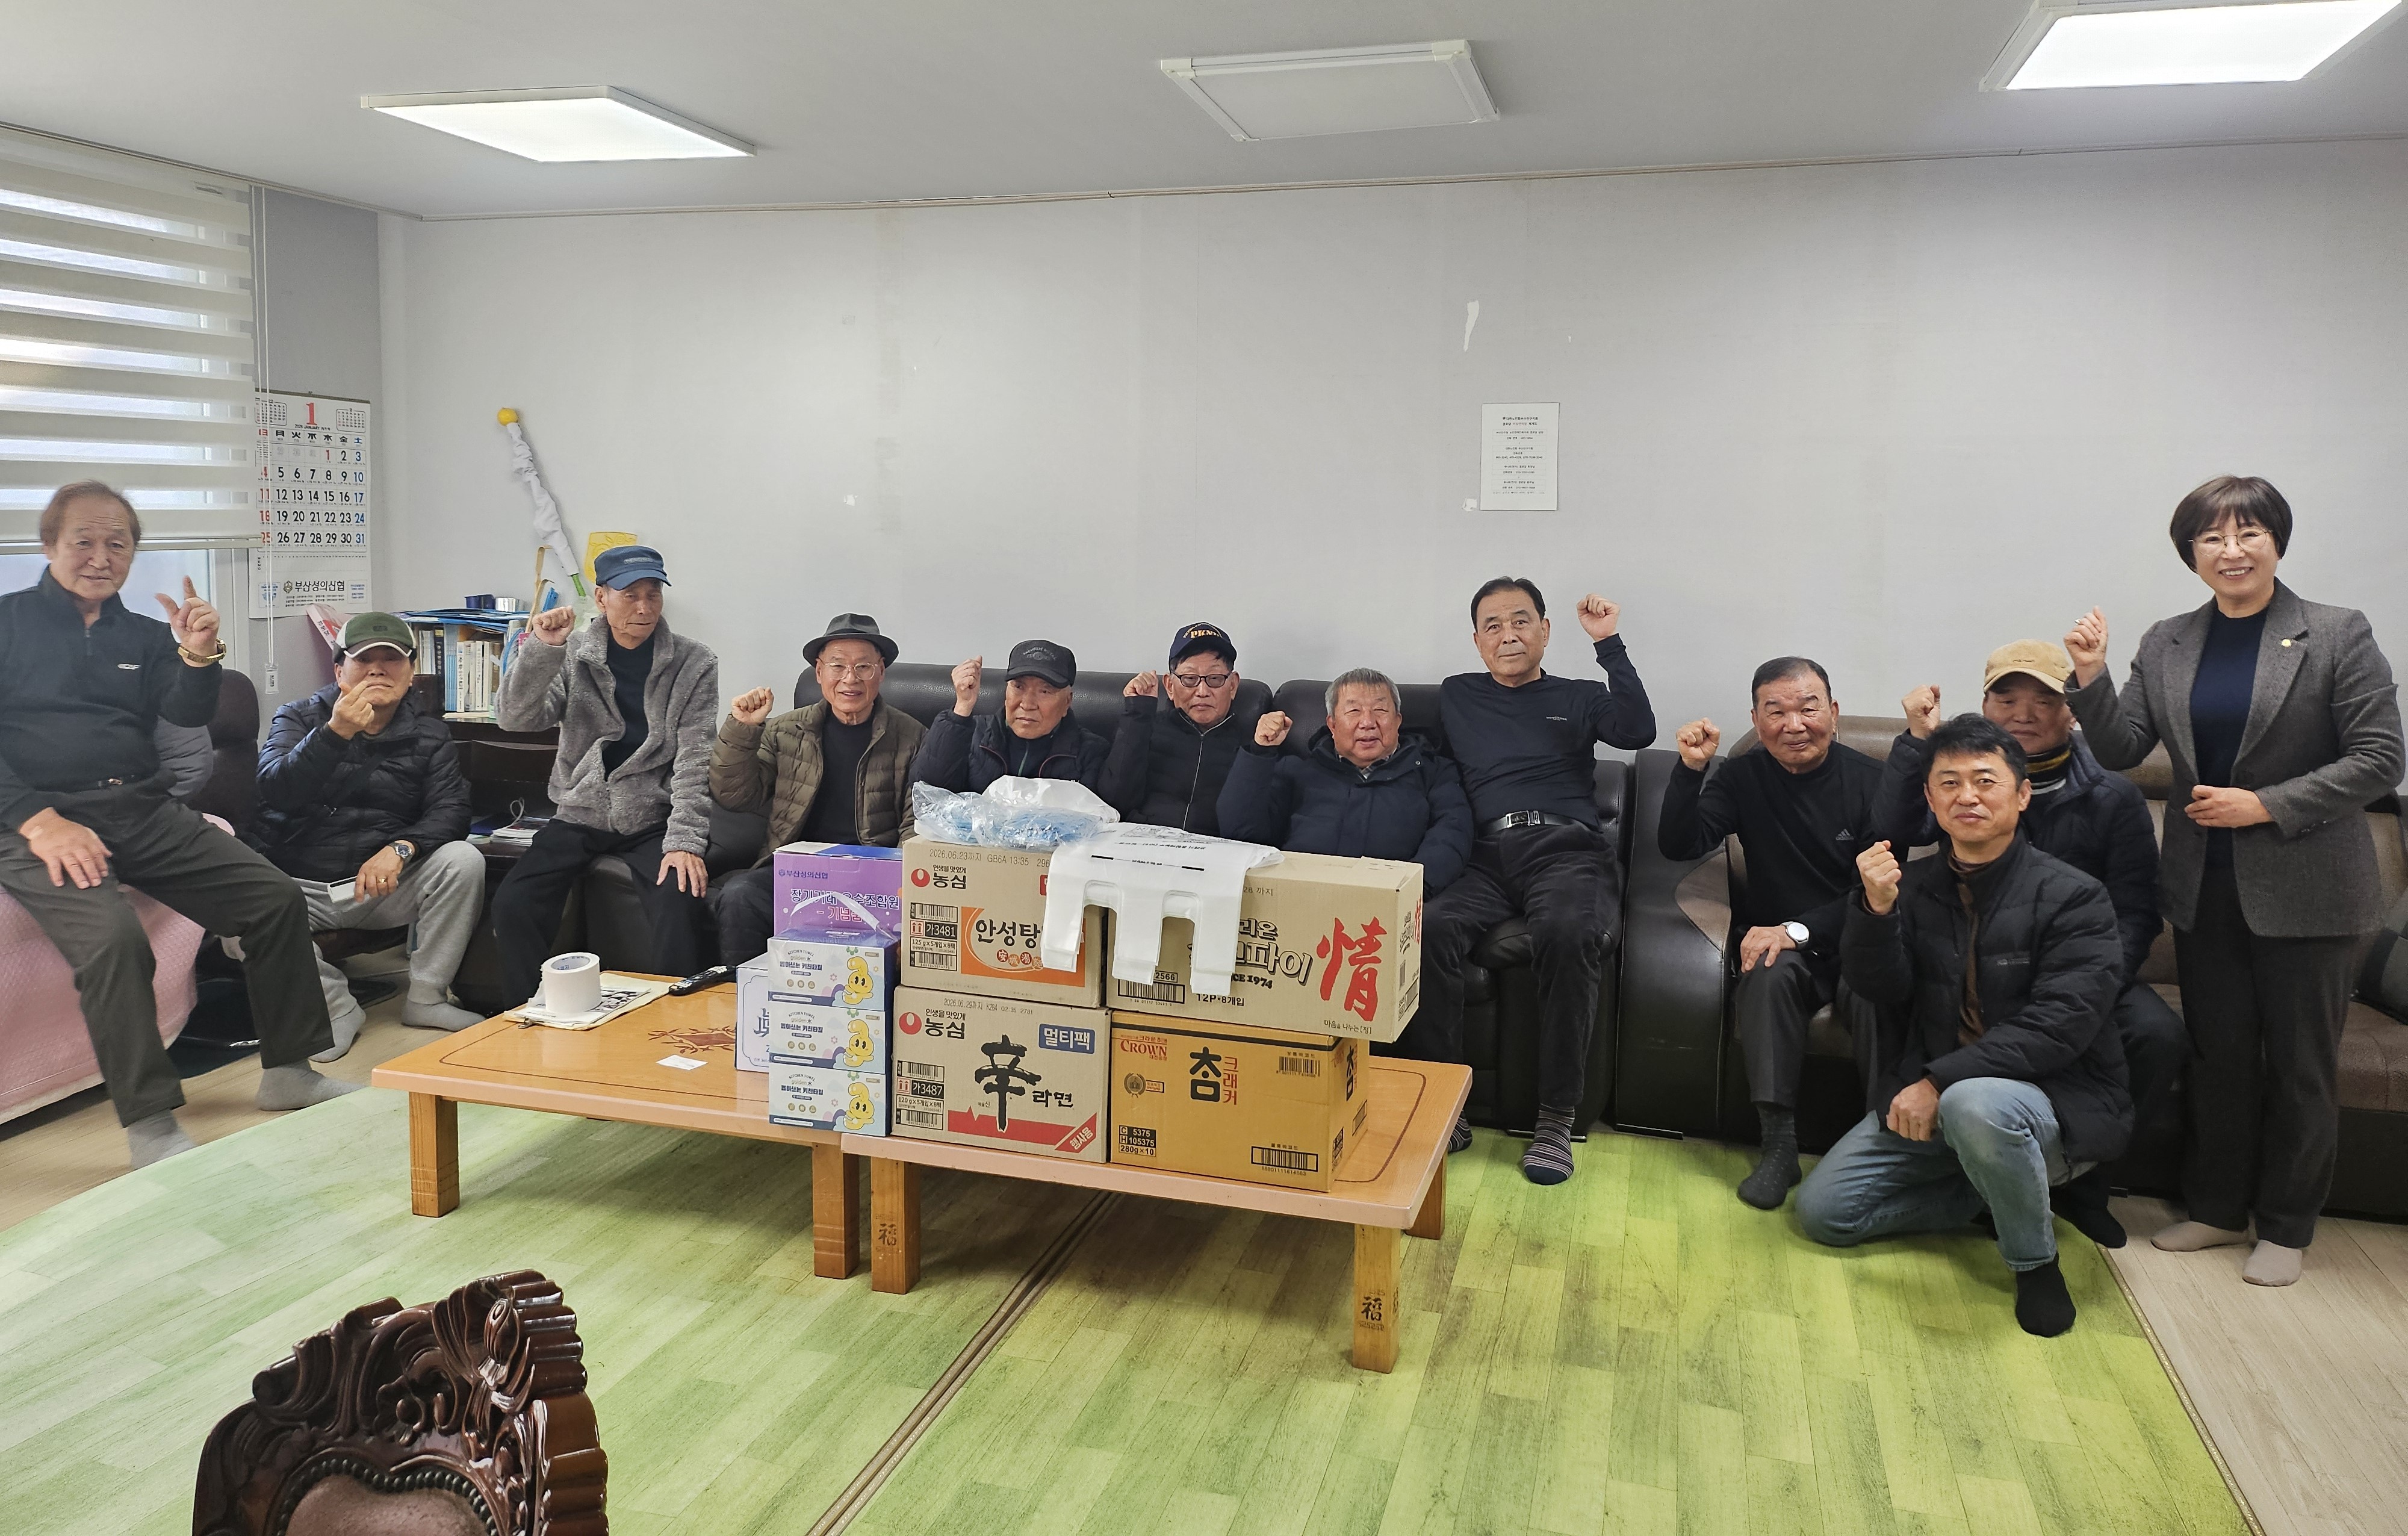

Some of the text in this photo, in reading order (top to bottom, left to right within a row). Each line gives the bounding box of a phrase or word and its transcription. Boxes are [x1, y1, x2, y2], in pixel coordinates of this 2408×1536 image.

[306, 402, 317, 425] 1
[326, 450, 330, 461] 1
[341, 450, 347, 461] 2
[355, 452, 361, 461] 3
[278, 467, 284, 478] 5
[294, 468, 300, 479] 6
[309, 469, 316, 480] 7
[326, 470, 332, 481] 8
[341, 471, 347, 482] 9
[354, 471, 364, 482] 10
[259, 488, 364, 503] 11 12 13 14 15 16 17
[259, 510, 365, 524] 18 19 20 21 22 23 24
[261, 532, 365, 544] 25 26 27 28 29 30 31
[294, 580, 345, 592] 부산성의신협
[929, 849, 981, 862] 2026.06.23까지
[987, 856, 1007, 864] GB6A
[1010, 856, 1029, 866] 13:35
[786, 871, 828, 879] 부산성의신협
[932, 872, 967, 889] 농심
[1256, 887, 1273, 897] 까지
[926, 923, 955, 937] 가3481
[975, 918, 1043, 949] 안성탕
[1239, 918, 1278, 941] 리온
[1155, 972, 1176, 981] 2566
[1317, 916, 1388, 1022] 情
[1247, 975, 1273, 989] 1974
[943, 998, 982, 1010] 2026.06.29까지
[925, 1009, 966, 1021] 인생을 맛있게
[924, 1018, 966, 1040] 농심
[1044, 1027, 1090, 1051] 멀티팩
[1120, 1039, 1167, 1056] CROWN
[974, 1034, 1042, 1132] 辛
[1223, 1056, 1238, 1105] 크래커
[912, 1082, 943, 1096] 가3487
[1032, 1089, 1074, 1108] 라면
[1069, 1126, 1093, 1150] 행사용
[1132, 1128, 1150, 1137] 5375
[1129, 1137, 1155, 1147] 105375
[878, 1223, 897, 1246] 福
[1361, 1296, 1382, 1321] 福
